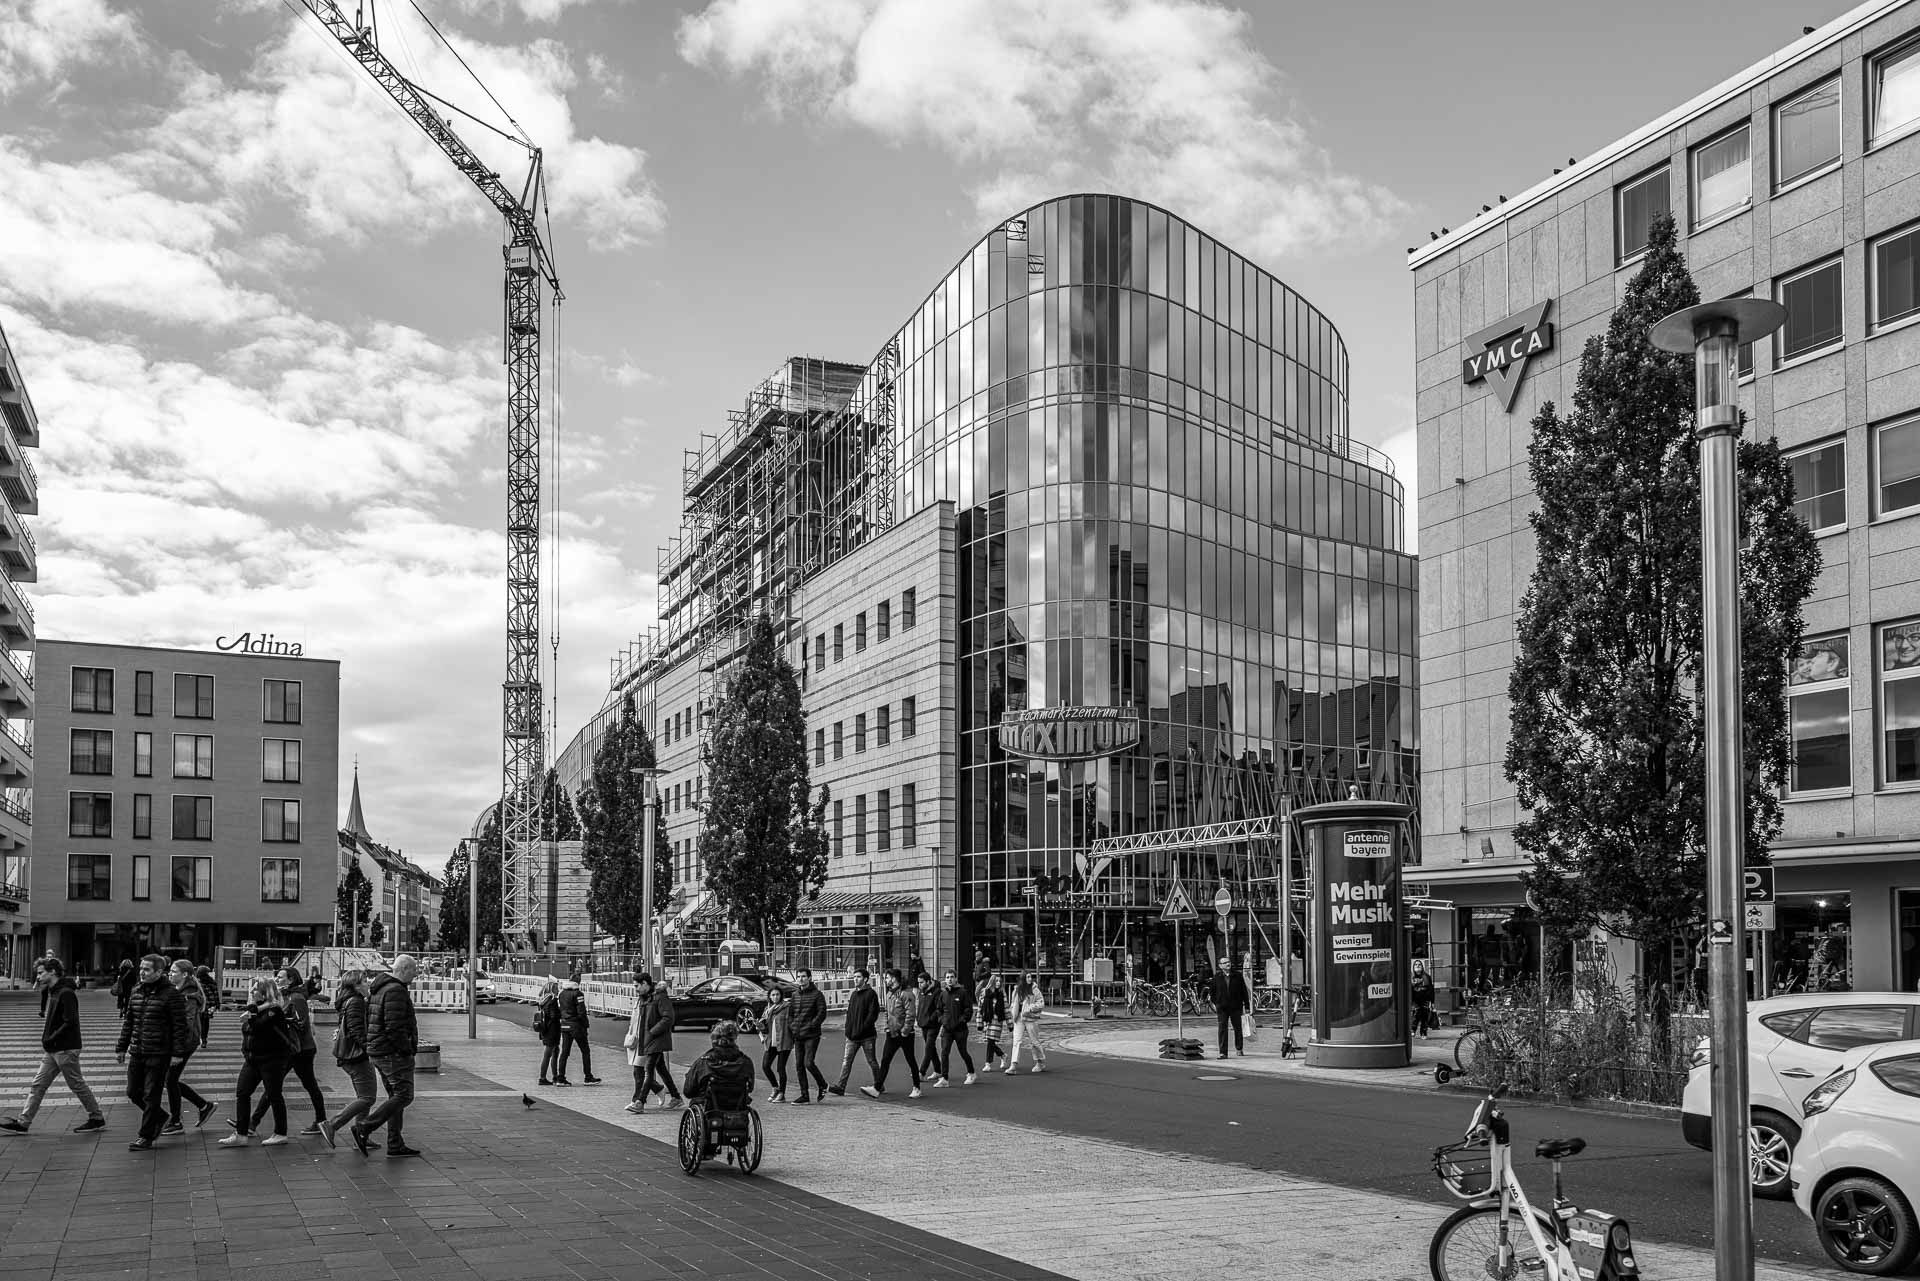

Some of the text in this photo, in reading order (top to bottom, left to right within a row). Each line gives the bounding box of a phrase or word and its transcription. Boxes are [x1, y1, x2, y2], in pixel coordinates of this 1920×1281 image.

[1469, 330, 1543, 377] YMCA
[216, 632, 304, 656] Adina
[1001, 721, 1136, 754] MAXIMUM
[1347, 833, 1389, 843] antenne
[1351, 845, 1387, 856] bayern
[1330, 880, 1386, 902] Mehr
[1744, 872, 1762, 899] P
[1331, 902, 1394, 925] Musik
[1335, 936, 1371, 946] weniger
[1335, 950, 1391, 960] Gewinnspiele
[1371, 986, 1391, 995] Neu!
